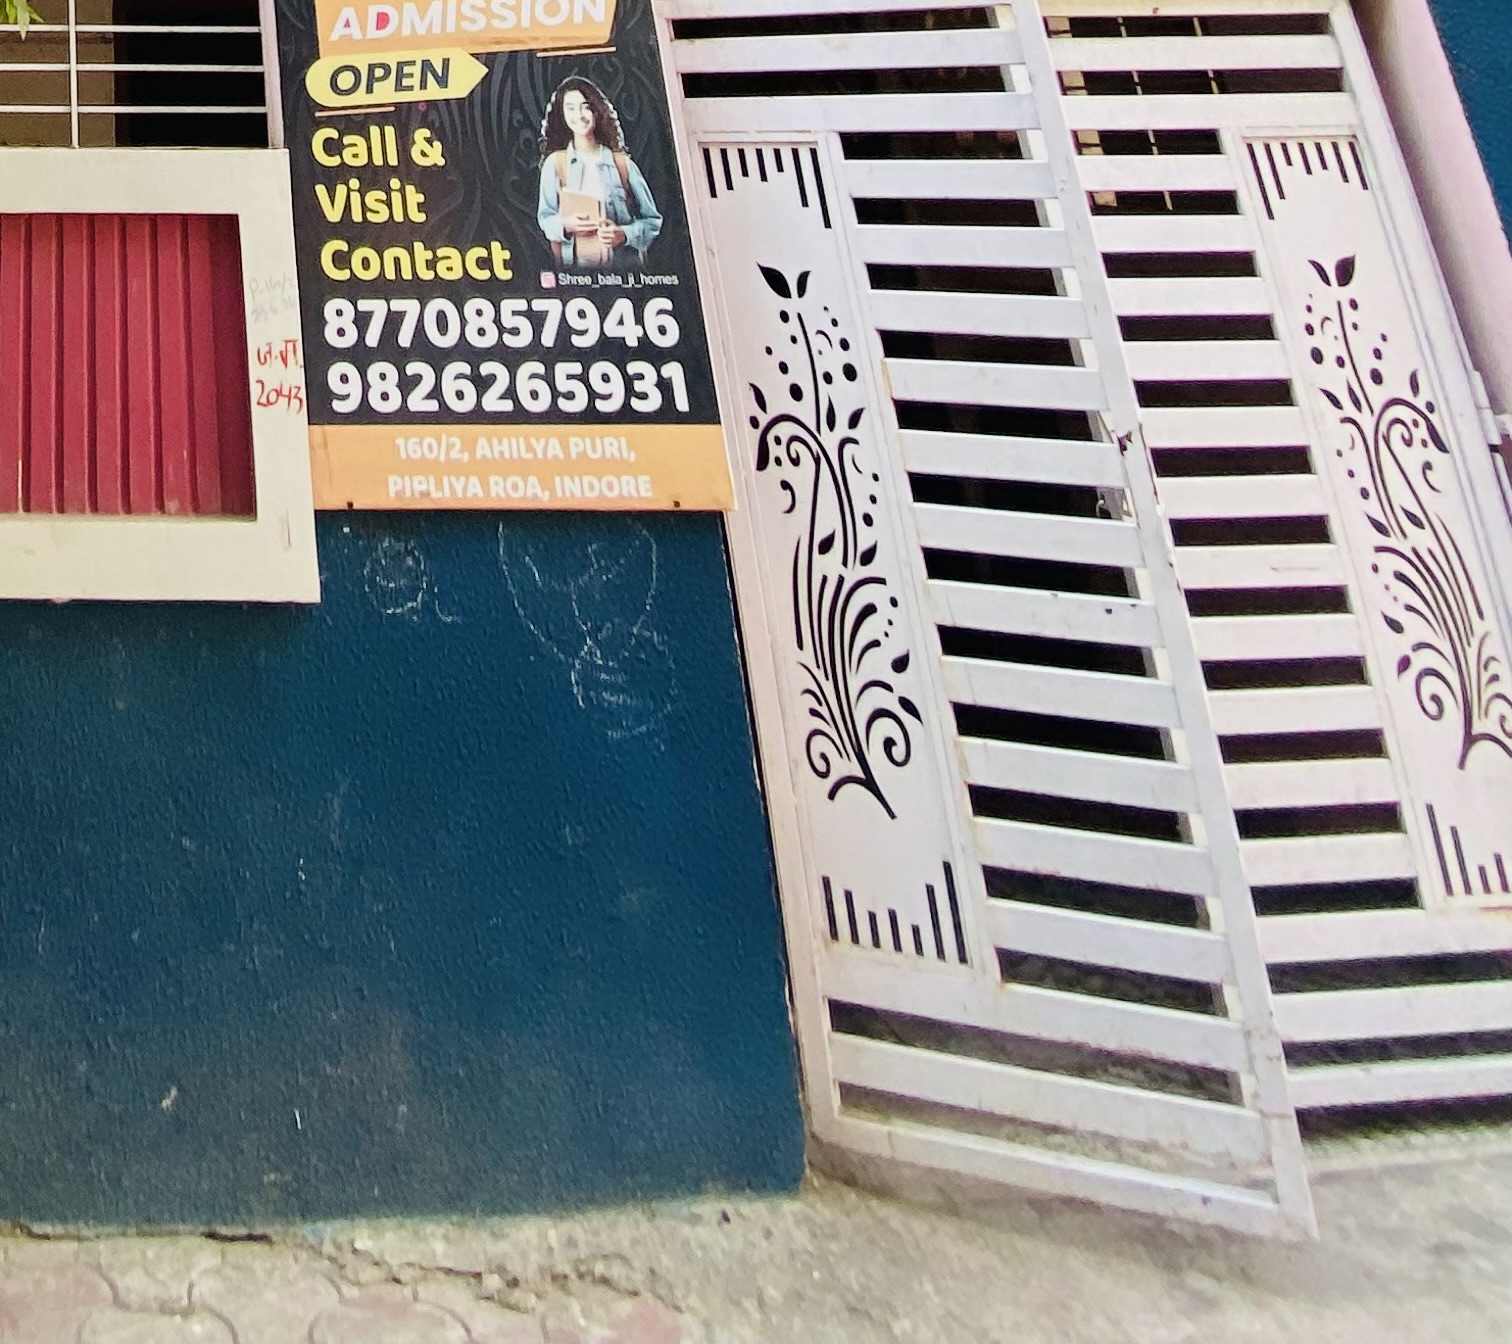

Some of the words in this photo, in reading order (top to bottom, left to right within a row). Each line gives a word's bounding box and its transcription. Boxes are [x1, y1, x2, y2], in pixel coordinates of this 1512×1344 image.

[328, 58, 451, 96] OPEN
[311, 125, 398, 167] Call
[410, 127, 446, 167] &
[315, 178, 427, 223] Visit
[320, 239, 513, 281] Contact
[323, 297, 680, 348] 8770857946
[326, 361, 690, 413] 9826265931
[395, 434, 469, 462] 160/2,
[475, 436, 564, 460] AHILYA
[569, 436, 635, 462] PURI,
[388, 474, 485, 498] PIPLIYA
[489, 475, 550, 501] ROA,
[554, 474, 653, 498] INDORE
